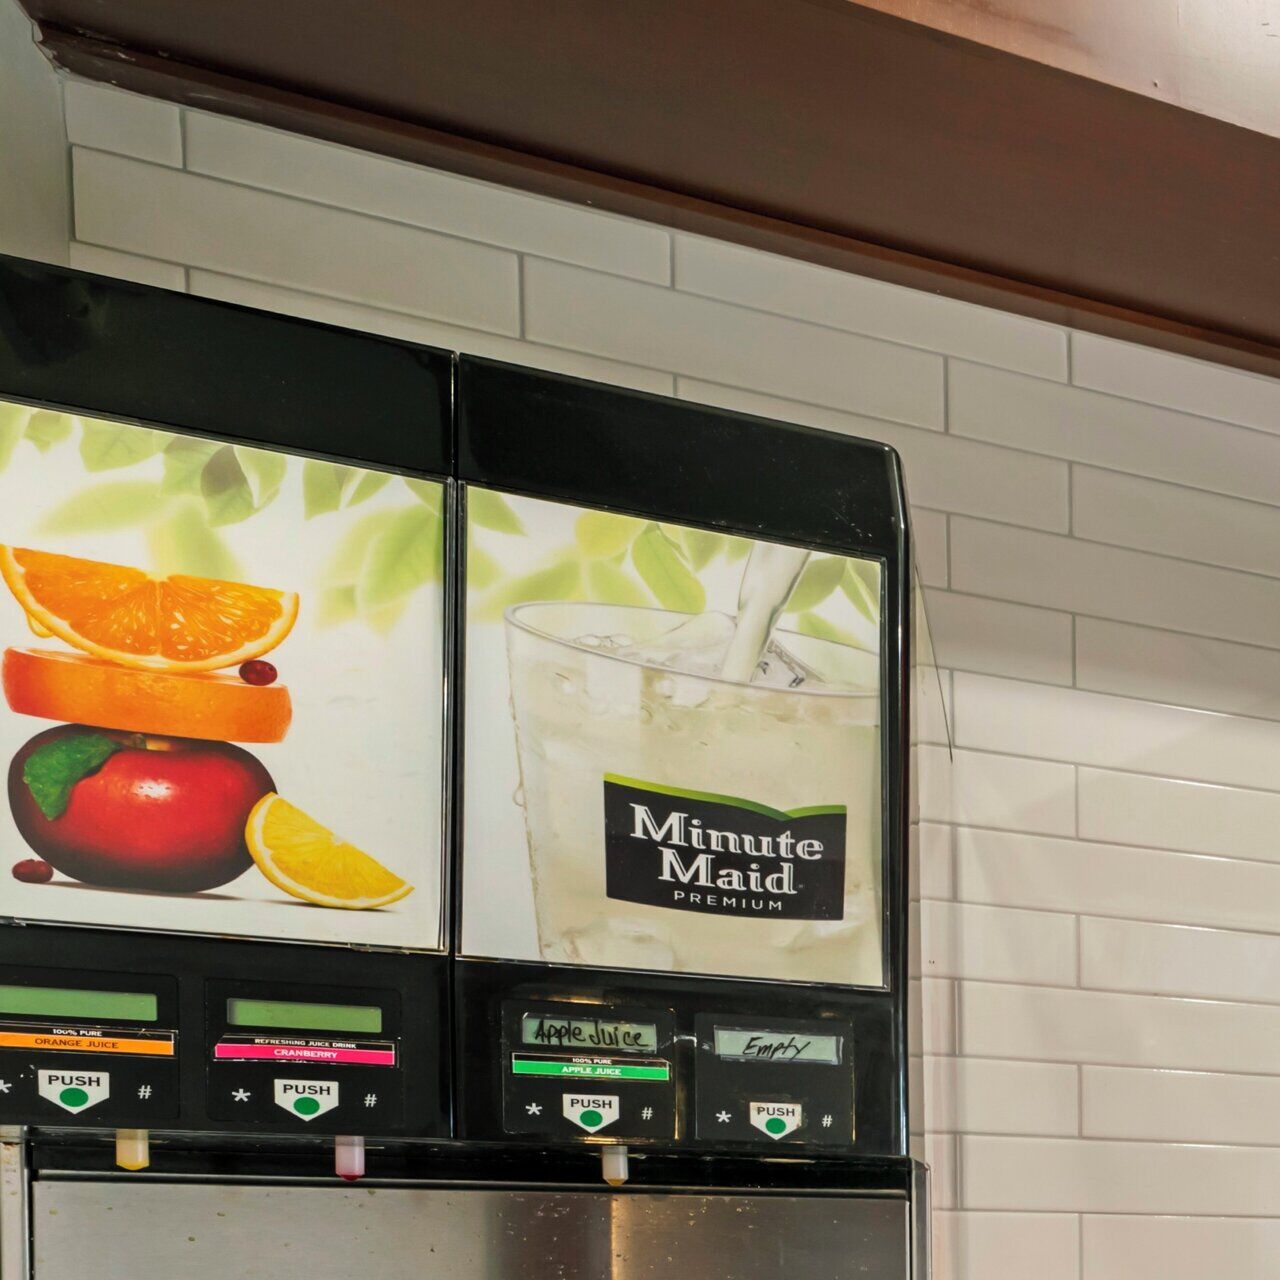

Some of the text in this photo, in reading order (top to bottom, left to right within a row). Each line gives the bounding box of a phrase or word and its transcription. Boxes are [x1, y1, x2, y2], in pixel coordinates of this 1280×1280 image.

[629, 803, 824, 860] Minute
[658, 846, 797, 894] Maid
[673, 890, 783, 911] PREMIUM
[52, 1028, 103, 1037] 100% PURE
[534, 1019, 650, 1048] Apple Juice
[34, 1038, 119, 1049] ORANGE JUICE
[254, 1038, 306, 1047] REFRESHING
[307, 1040, 330, 1048] JUICE
[742, 1036, 811, 1060] Empty
[274, 1048, 338, 1059] CRANBERRY
[561, 1065, 622, 1076] APPLE JUICE
[48, 1074, 101, 1087] PUSH
[283, 1084, 331, 1096] PUSH
[570, 1098, 613, 1109] PUSH
[757, 1106, 796, 1117] PUSH
